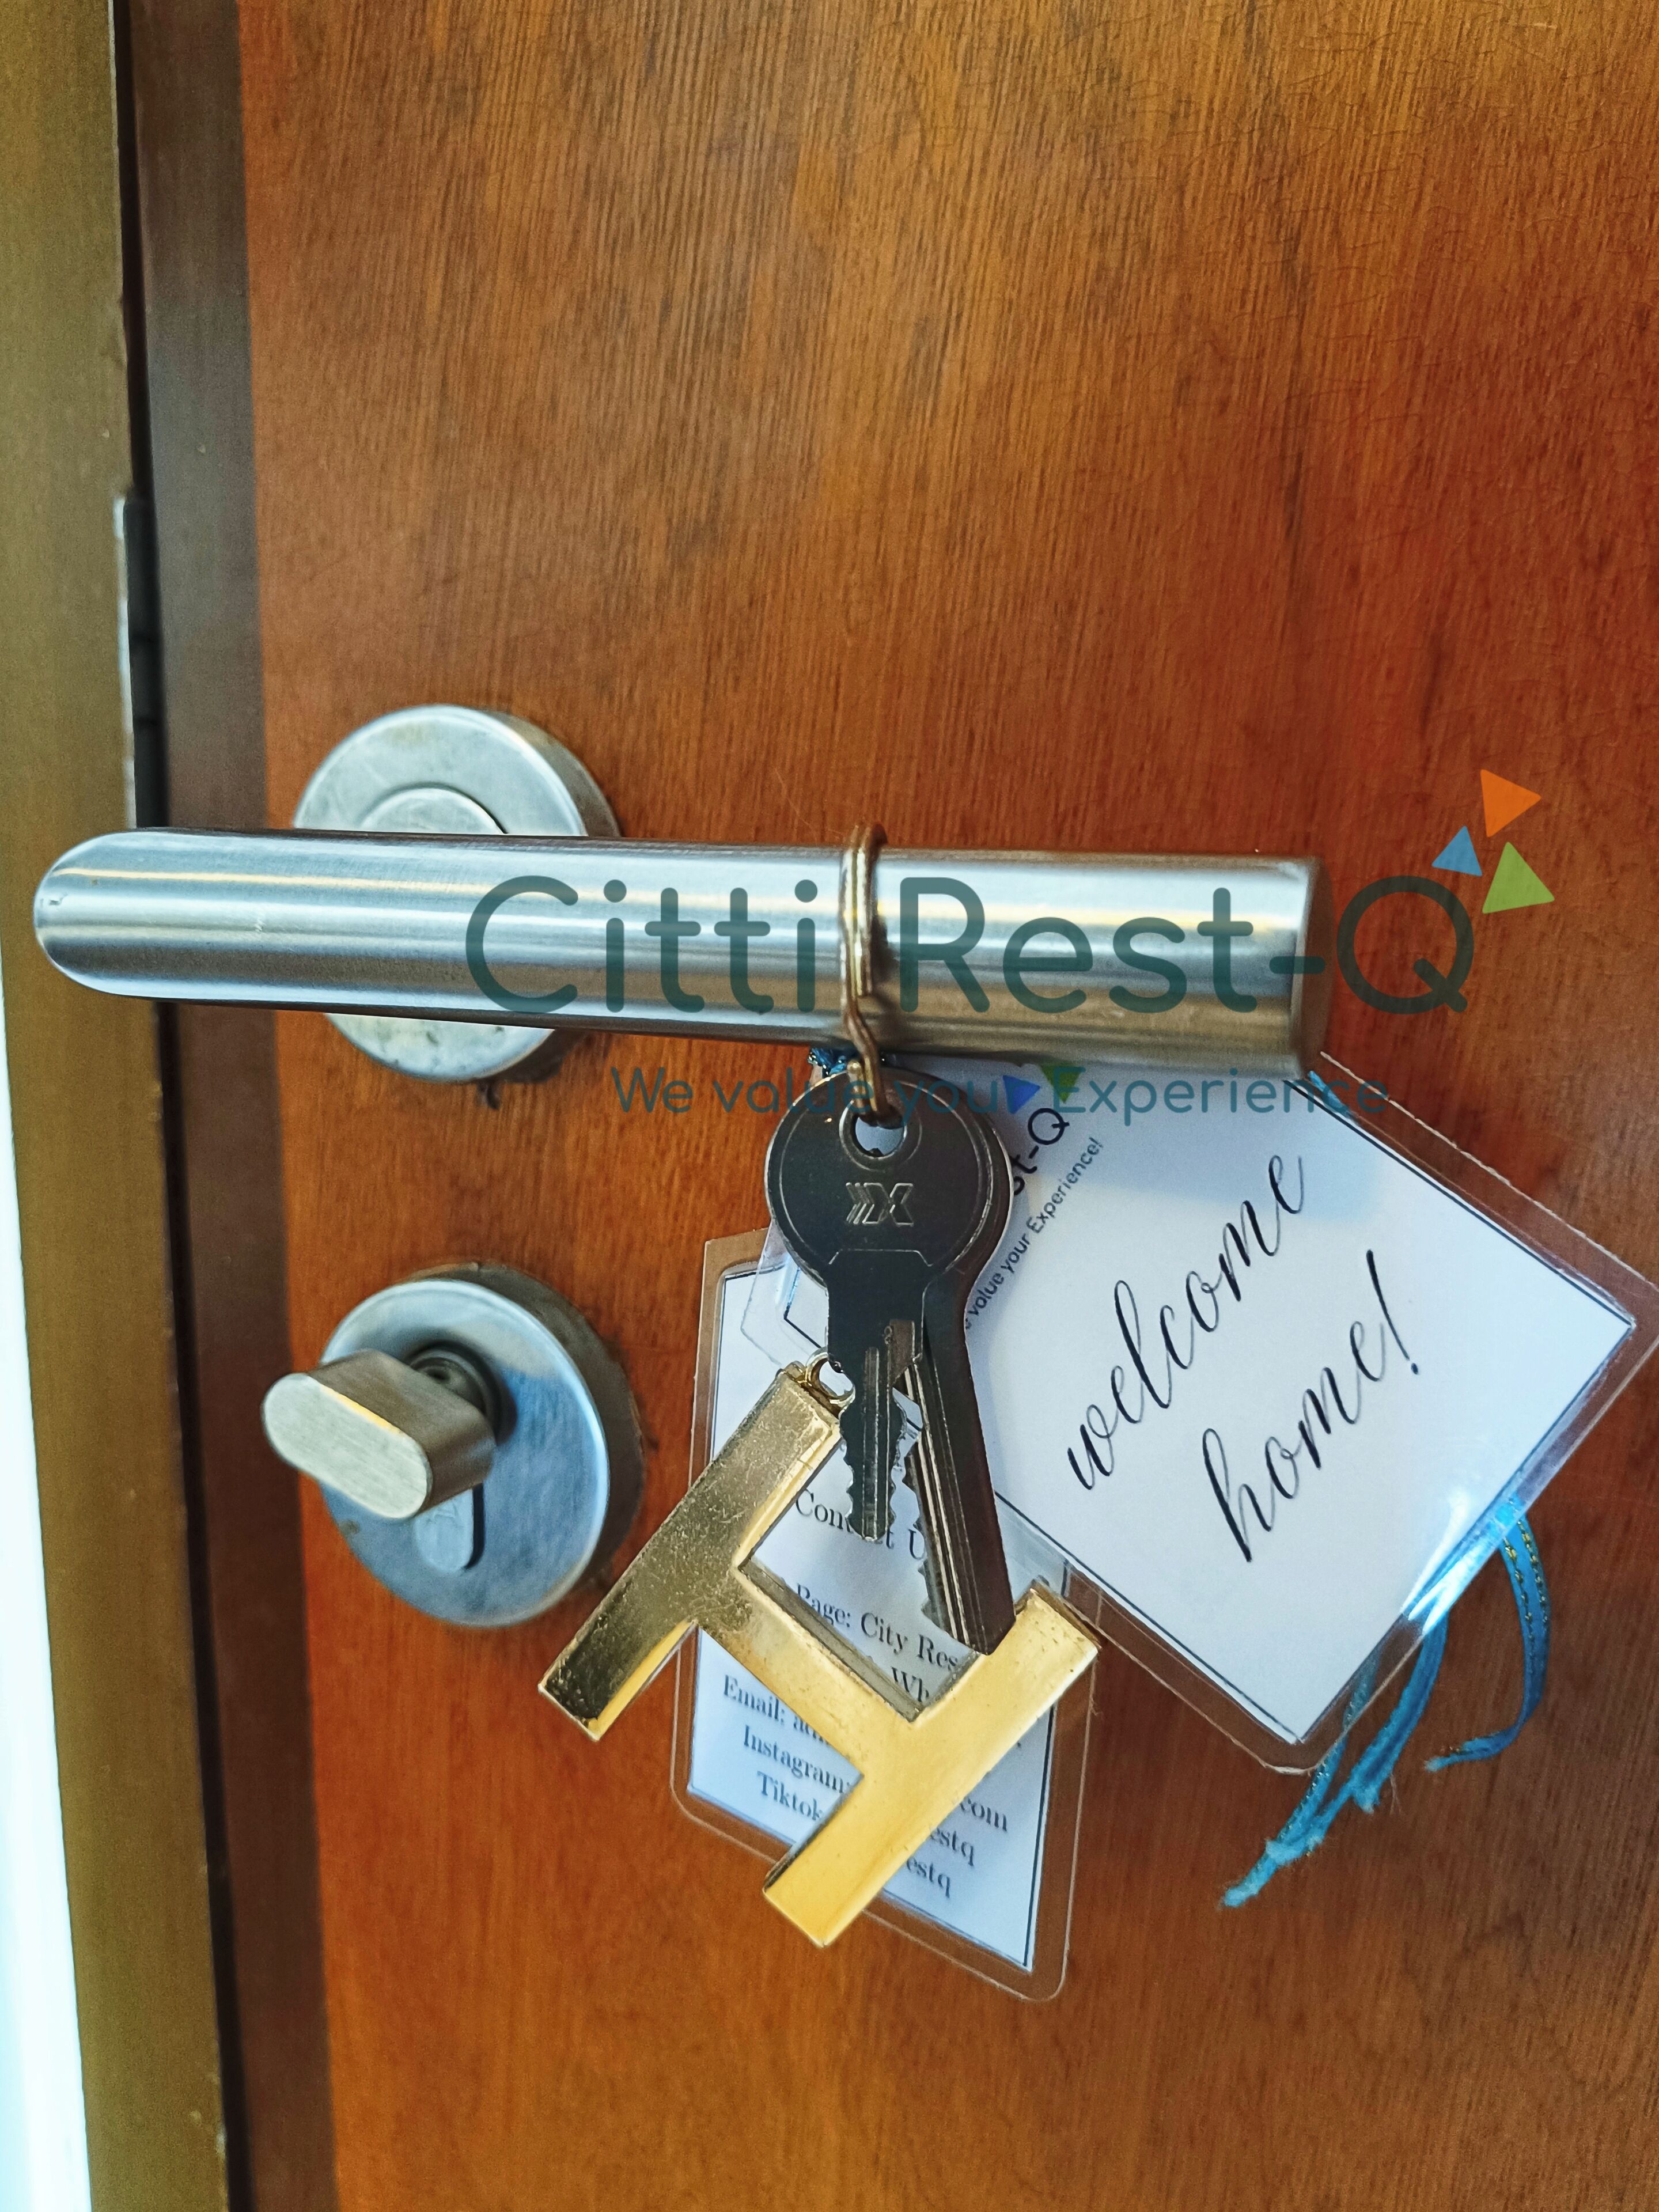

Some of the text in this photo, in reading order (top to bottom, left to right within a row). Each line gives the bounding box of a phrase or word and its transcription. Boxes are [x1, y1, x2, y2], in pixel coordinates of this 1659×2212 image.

[967, 1137, 1104, 1317] value your Experience!
[1067, 1154, 1305, 1491] welcome
[1202, 1249, 1419, 1563] home!
[908, 1529, 927, 1560] U
[723, 1674, 785, 1726] Email:
[860, 1612, 908, 1655] City
[918, 1634, 959, 1671] Res
